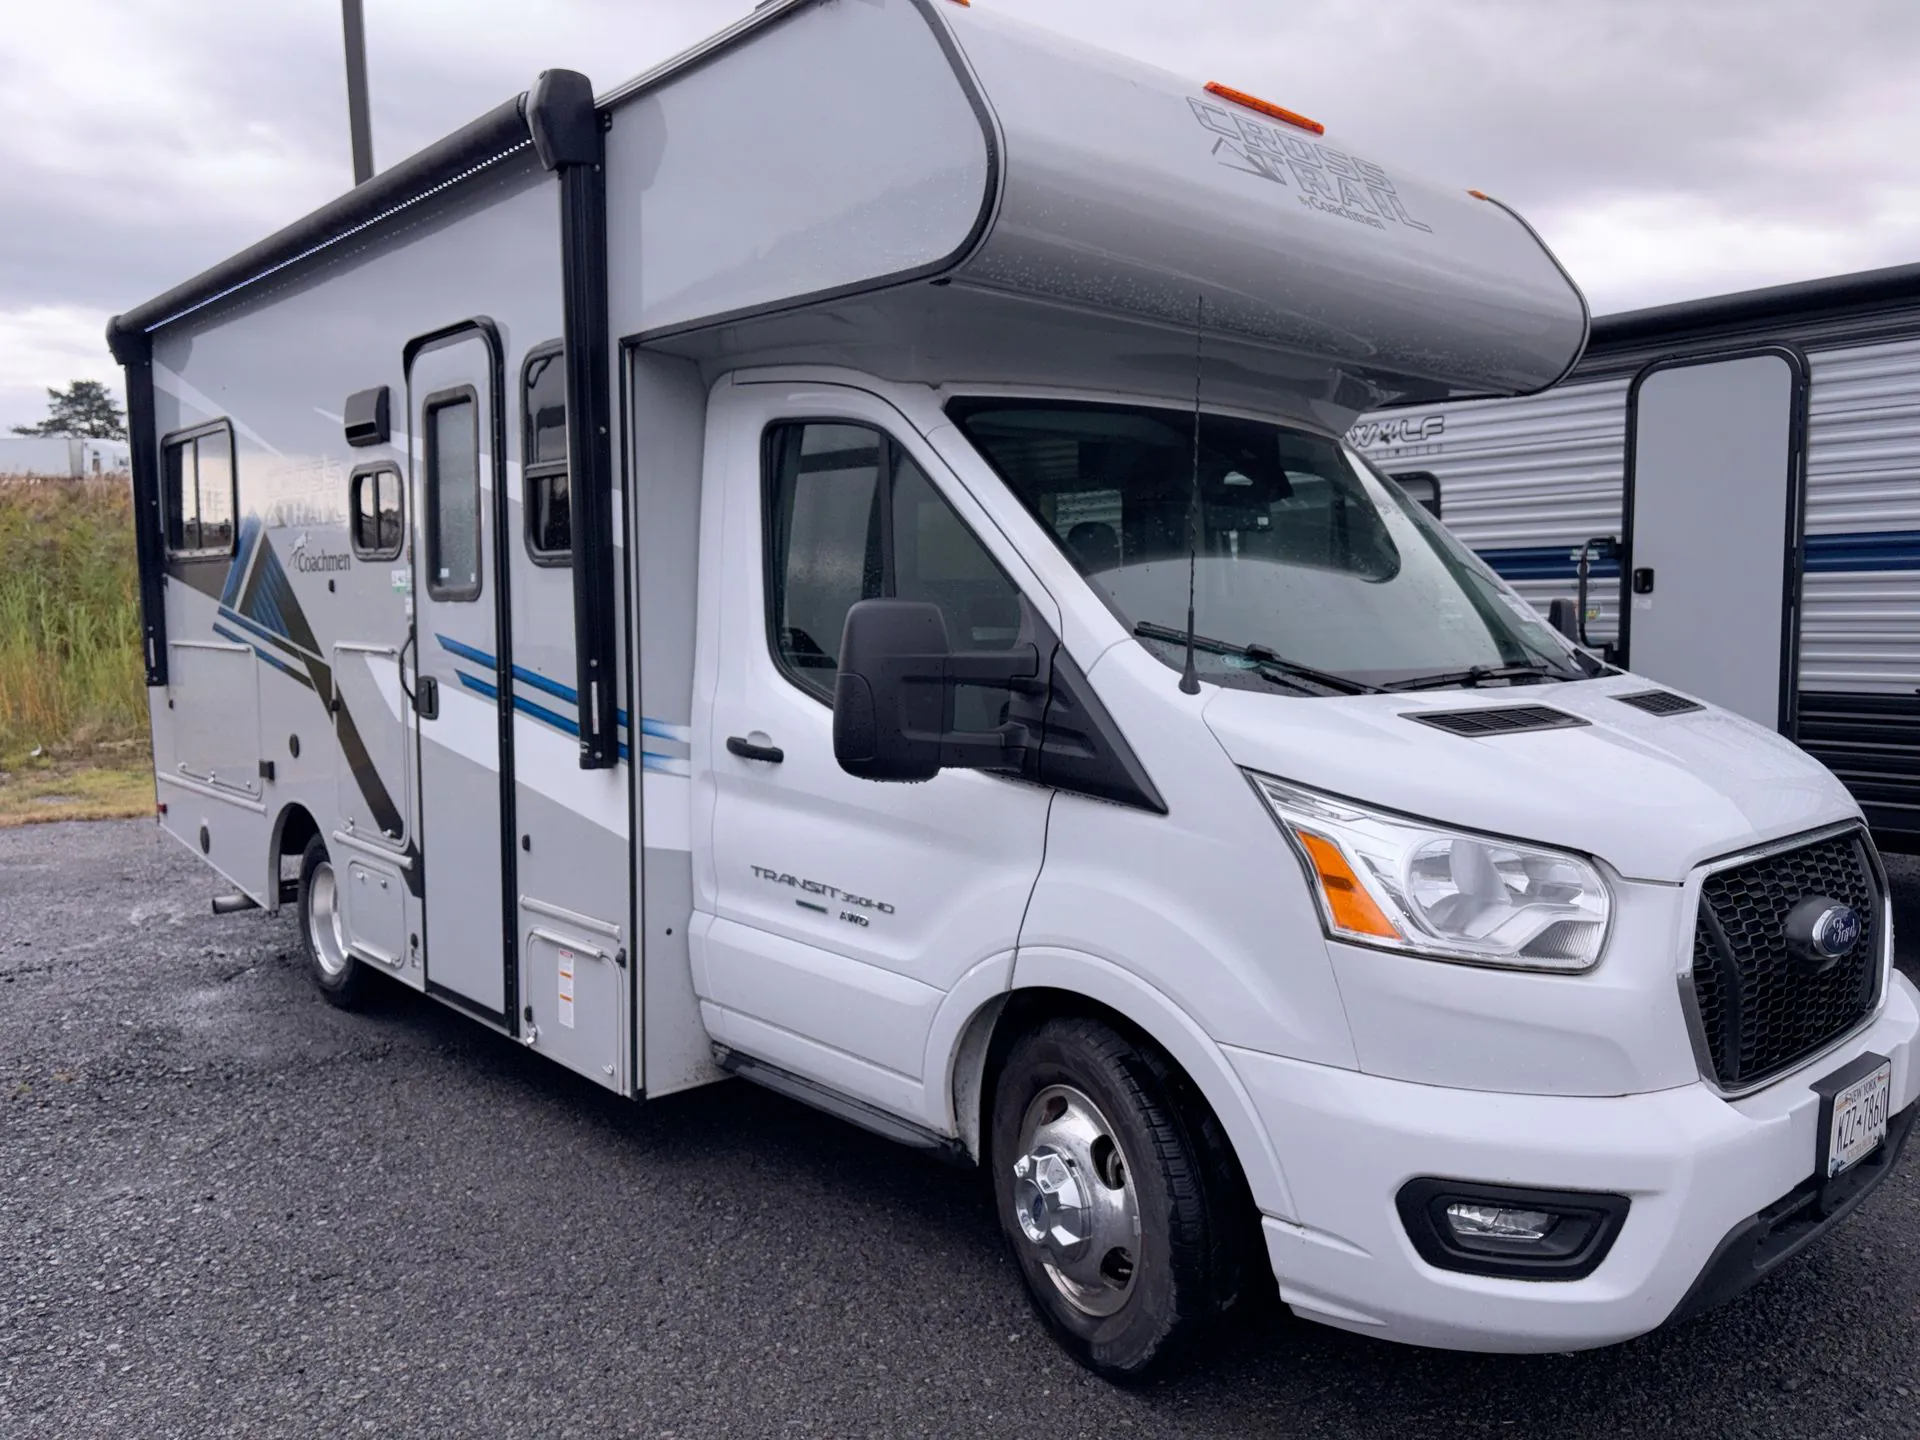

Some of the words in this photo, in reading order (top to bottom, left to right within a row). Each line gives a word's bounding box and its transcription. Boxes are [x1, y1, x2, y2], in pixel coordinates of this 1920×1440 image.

[1186, 96, 1397, 195] CROSS
[1241, 143, 1434, 234] TRAIL
[1308, 198, 1387, 231] Coachmen
[298, 548, 350, 573] Coachmen
[750, 864, 841, 899] TRANSIT
[840, 891, 895, 914] 350HD
[839, 911, 870, 928] AWD
[1832, 917, 1857, 944] Ford
[1862, 1086, 1886, 1137] 7860
